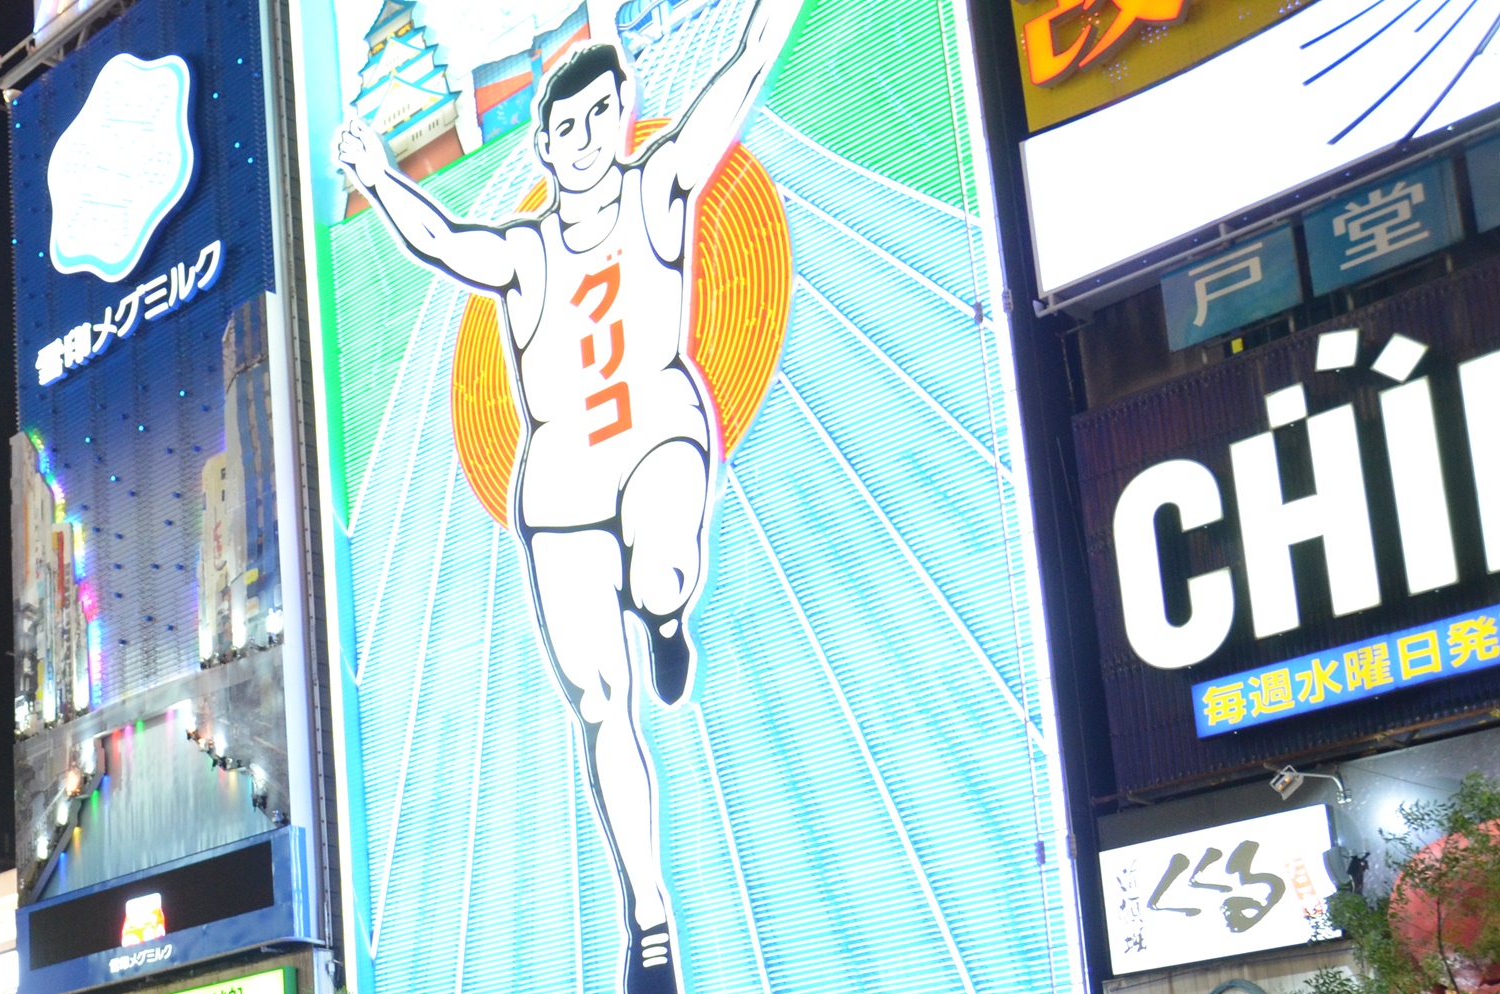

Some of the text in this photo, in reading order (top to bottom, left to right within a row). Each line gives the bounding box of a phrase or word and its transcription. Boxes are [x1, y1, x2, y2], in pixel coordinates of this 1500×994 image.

[35, 239, 224, 385] 雪印メグミルク
[569, 248, 633, 447] グリコ
[1146, 839, 1287, 935] くくる
